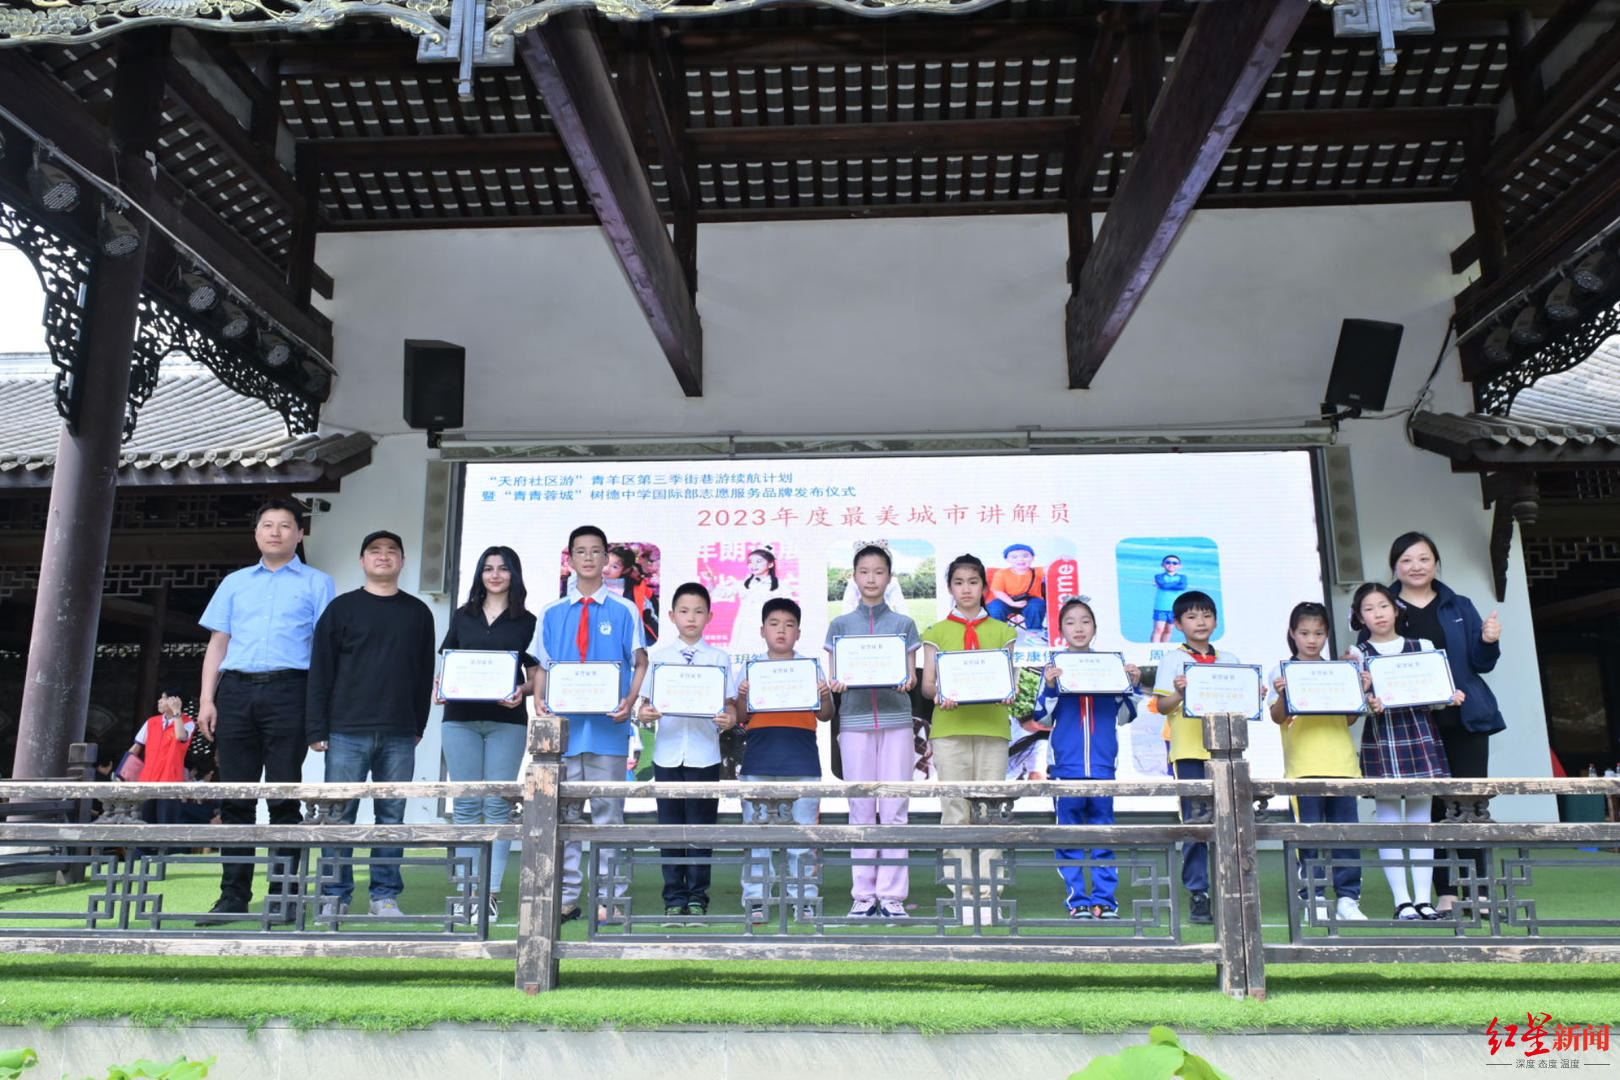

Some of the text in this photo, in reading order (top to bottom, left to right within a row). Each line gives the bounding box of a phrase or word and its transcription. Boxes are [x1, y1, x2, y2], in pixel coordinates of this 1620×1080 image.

[697, 503, 1070, 528] 2023年度最美城市讲解员
